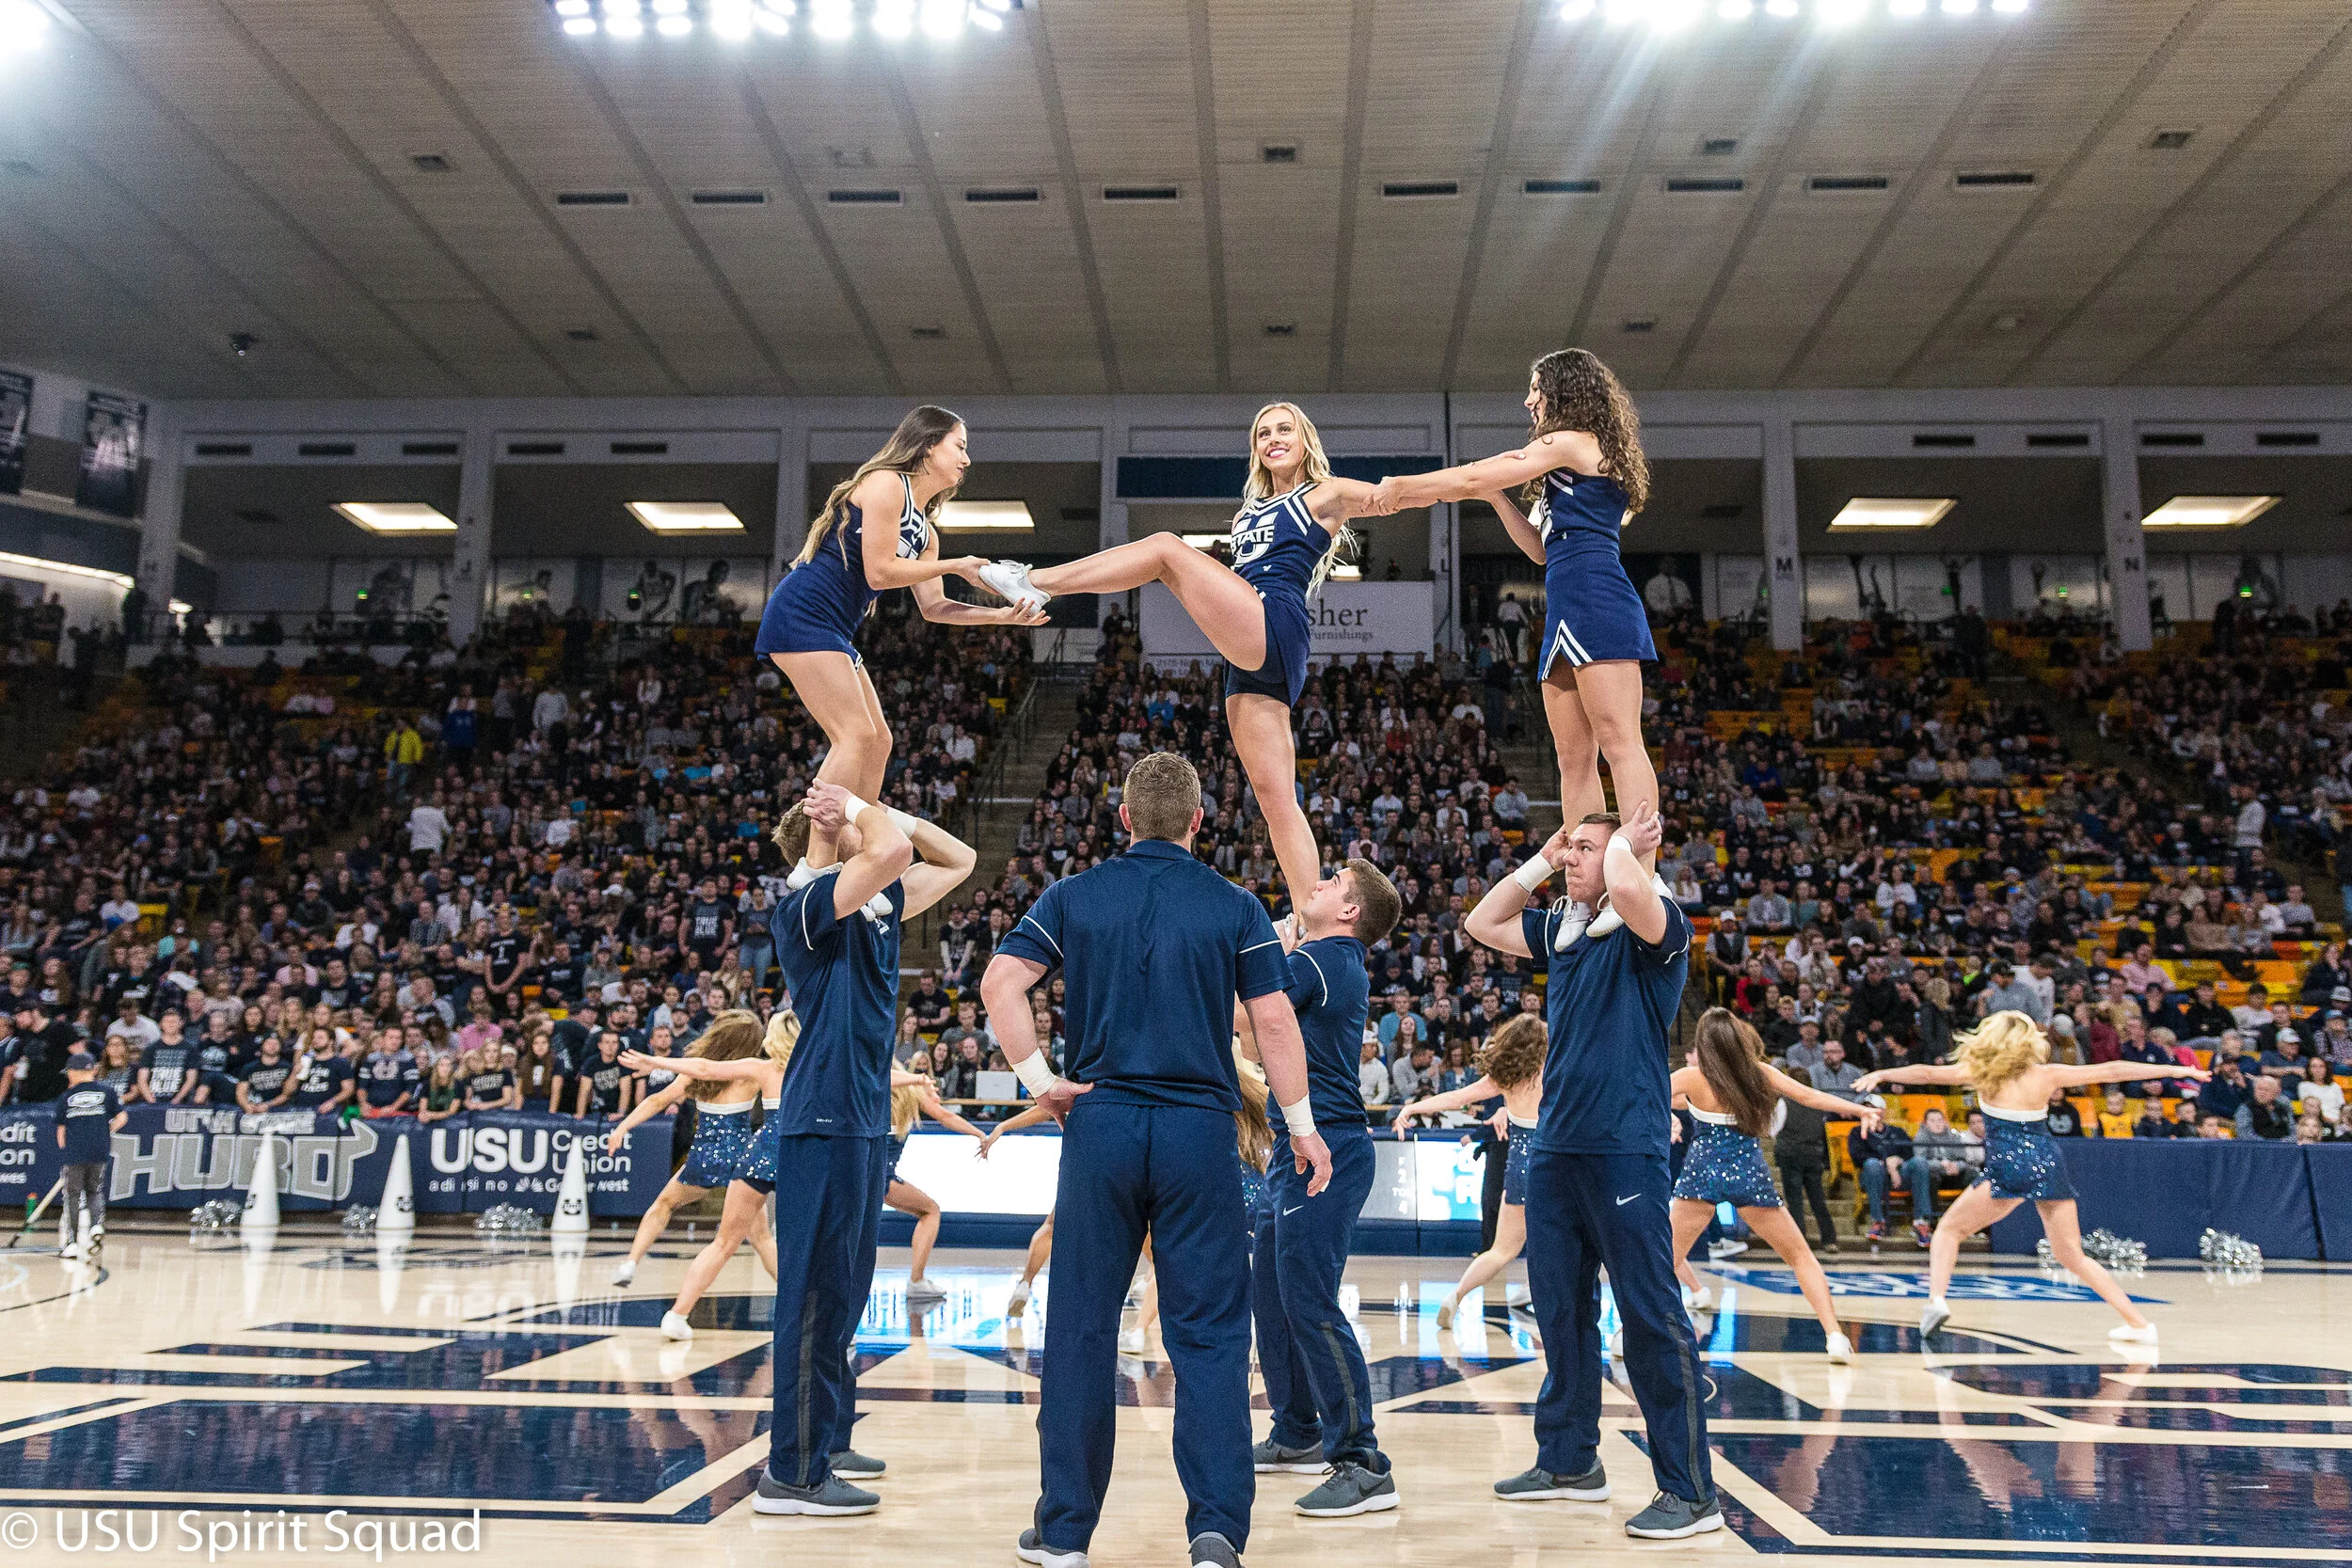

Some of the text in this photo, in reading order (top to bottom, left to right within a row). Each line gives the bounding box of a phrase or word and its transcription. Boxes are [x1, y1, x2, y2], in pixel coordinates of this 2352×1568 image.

[1776, 557, 1793, 572] M
[431, 1127, 548, 1174] USU
[552, 1128, 632, 1151] Cedt
